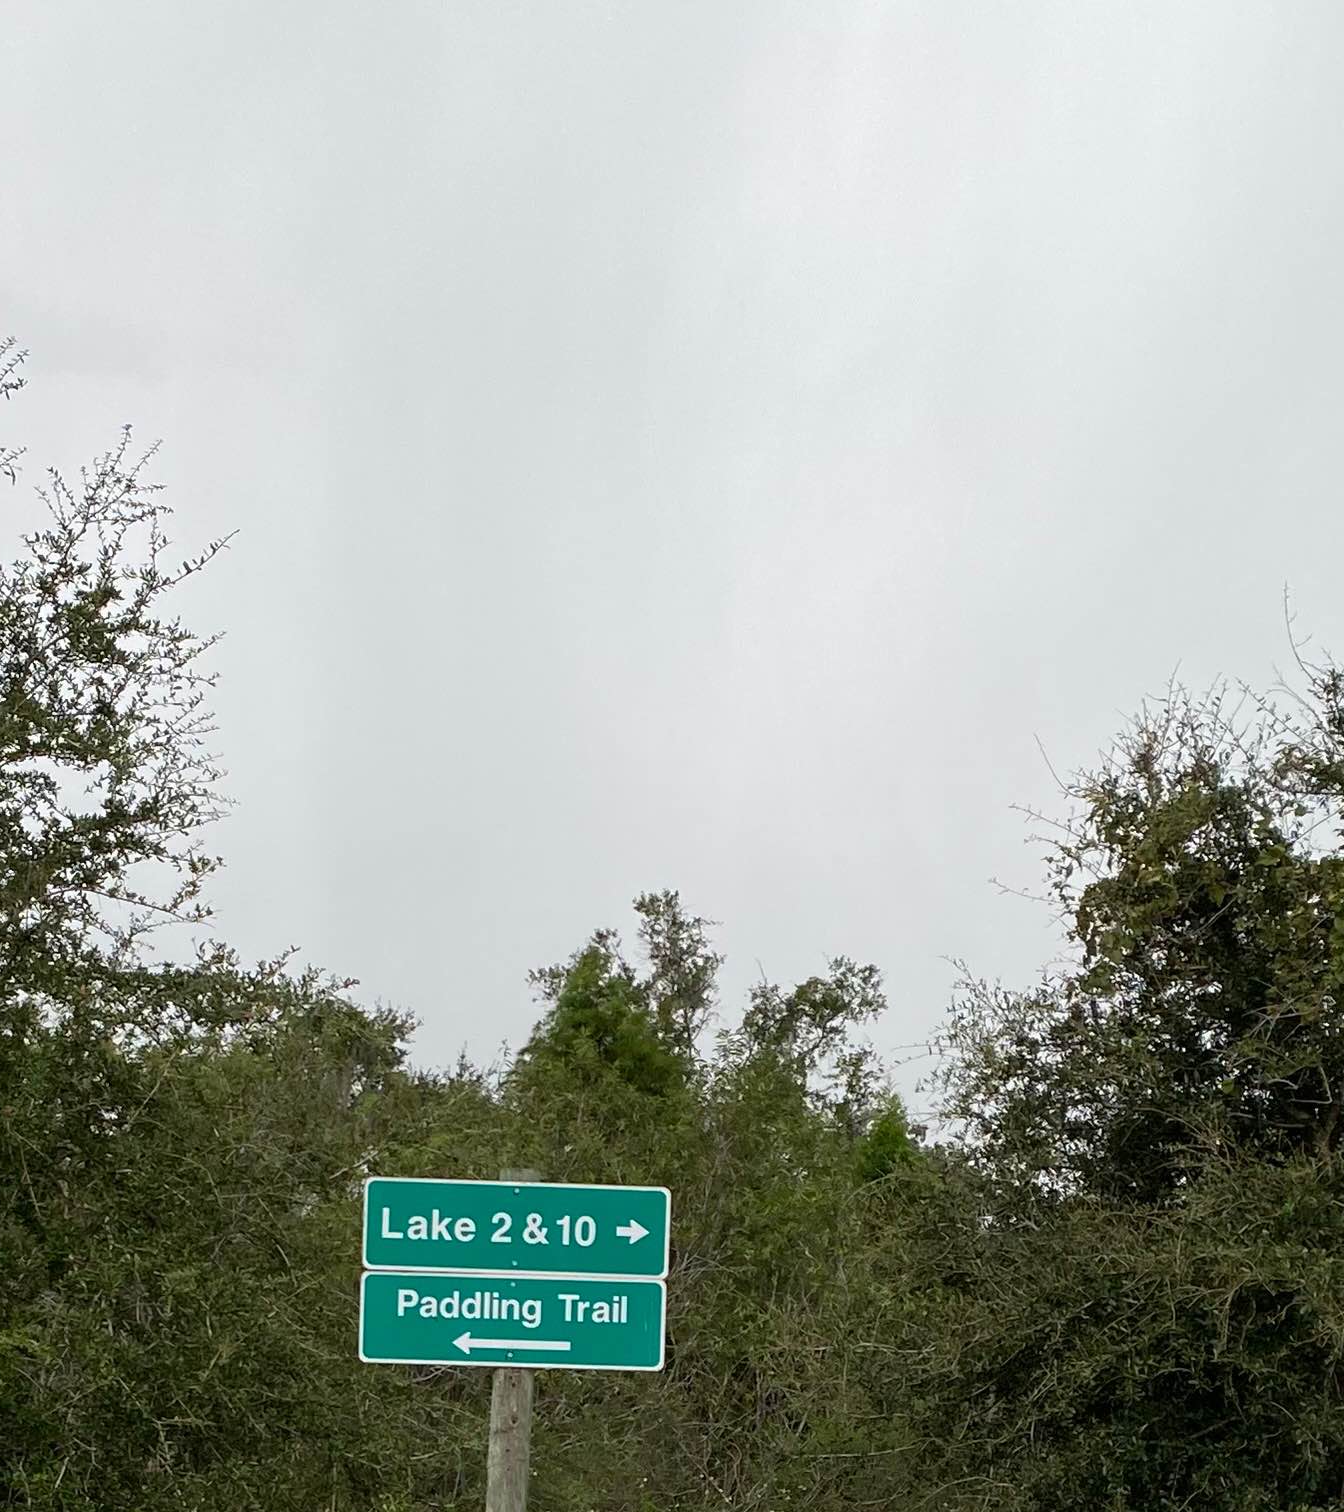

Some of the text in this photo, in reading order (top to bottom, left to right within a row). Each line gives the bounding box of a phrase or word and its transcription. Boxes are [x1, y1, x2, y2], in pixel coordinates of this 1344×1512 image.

[381, 1207, 476, 1242] Lake
[397, 1289, 628, 1328] Paddling Trail
